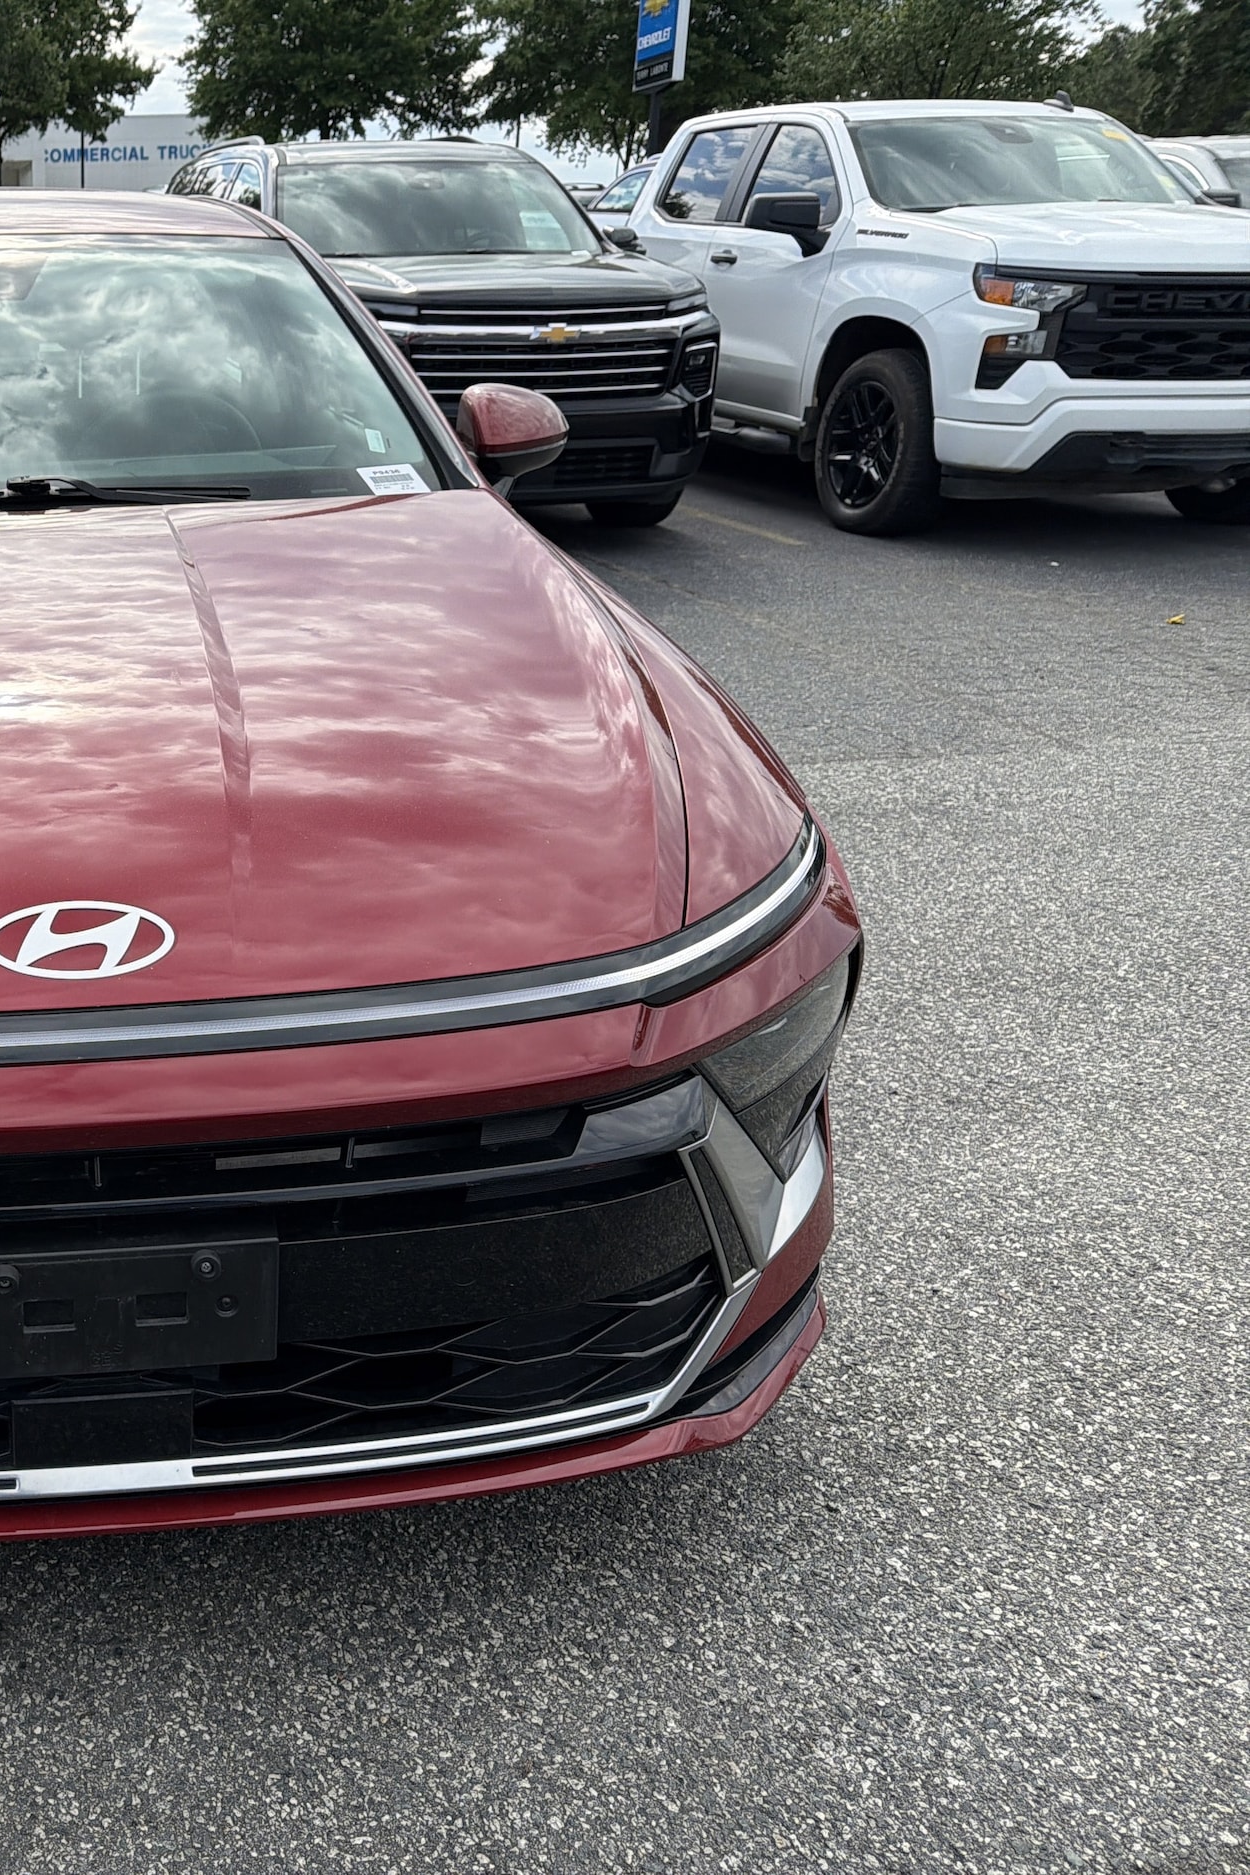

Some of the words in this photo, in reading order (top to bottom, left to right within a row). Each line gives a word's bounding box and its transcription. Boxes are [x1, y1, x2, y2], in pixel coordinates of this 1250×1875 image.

[638, 27, 672, 50] CHEVROLET
[157, 144, 213, 160] TRUC
[856, 228, 910, 239] SILVERADO
[1106, 290, 1250, 313] CHEV
